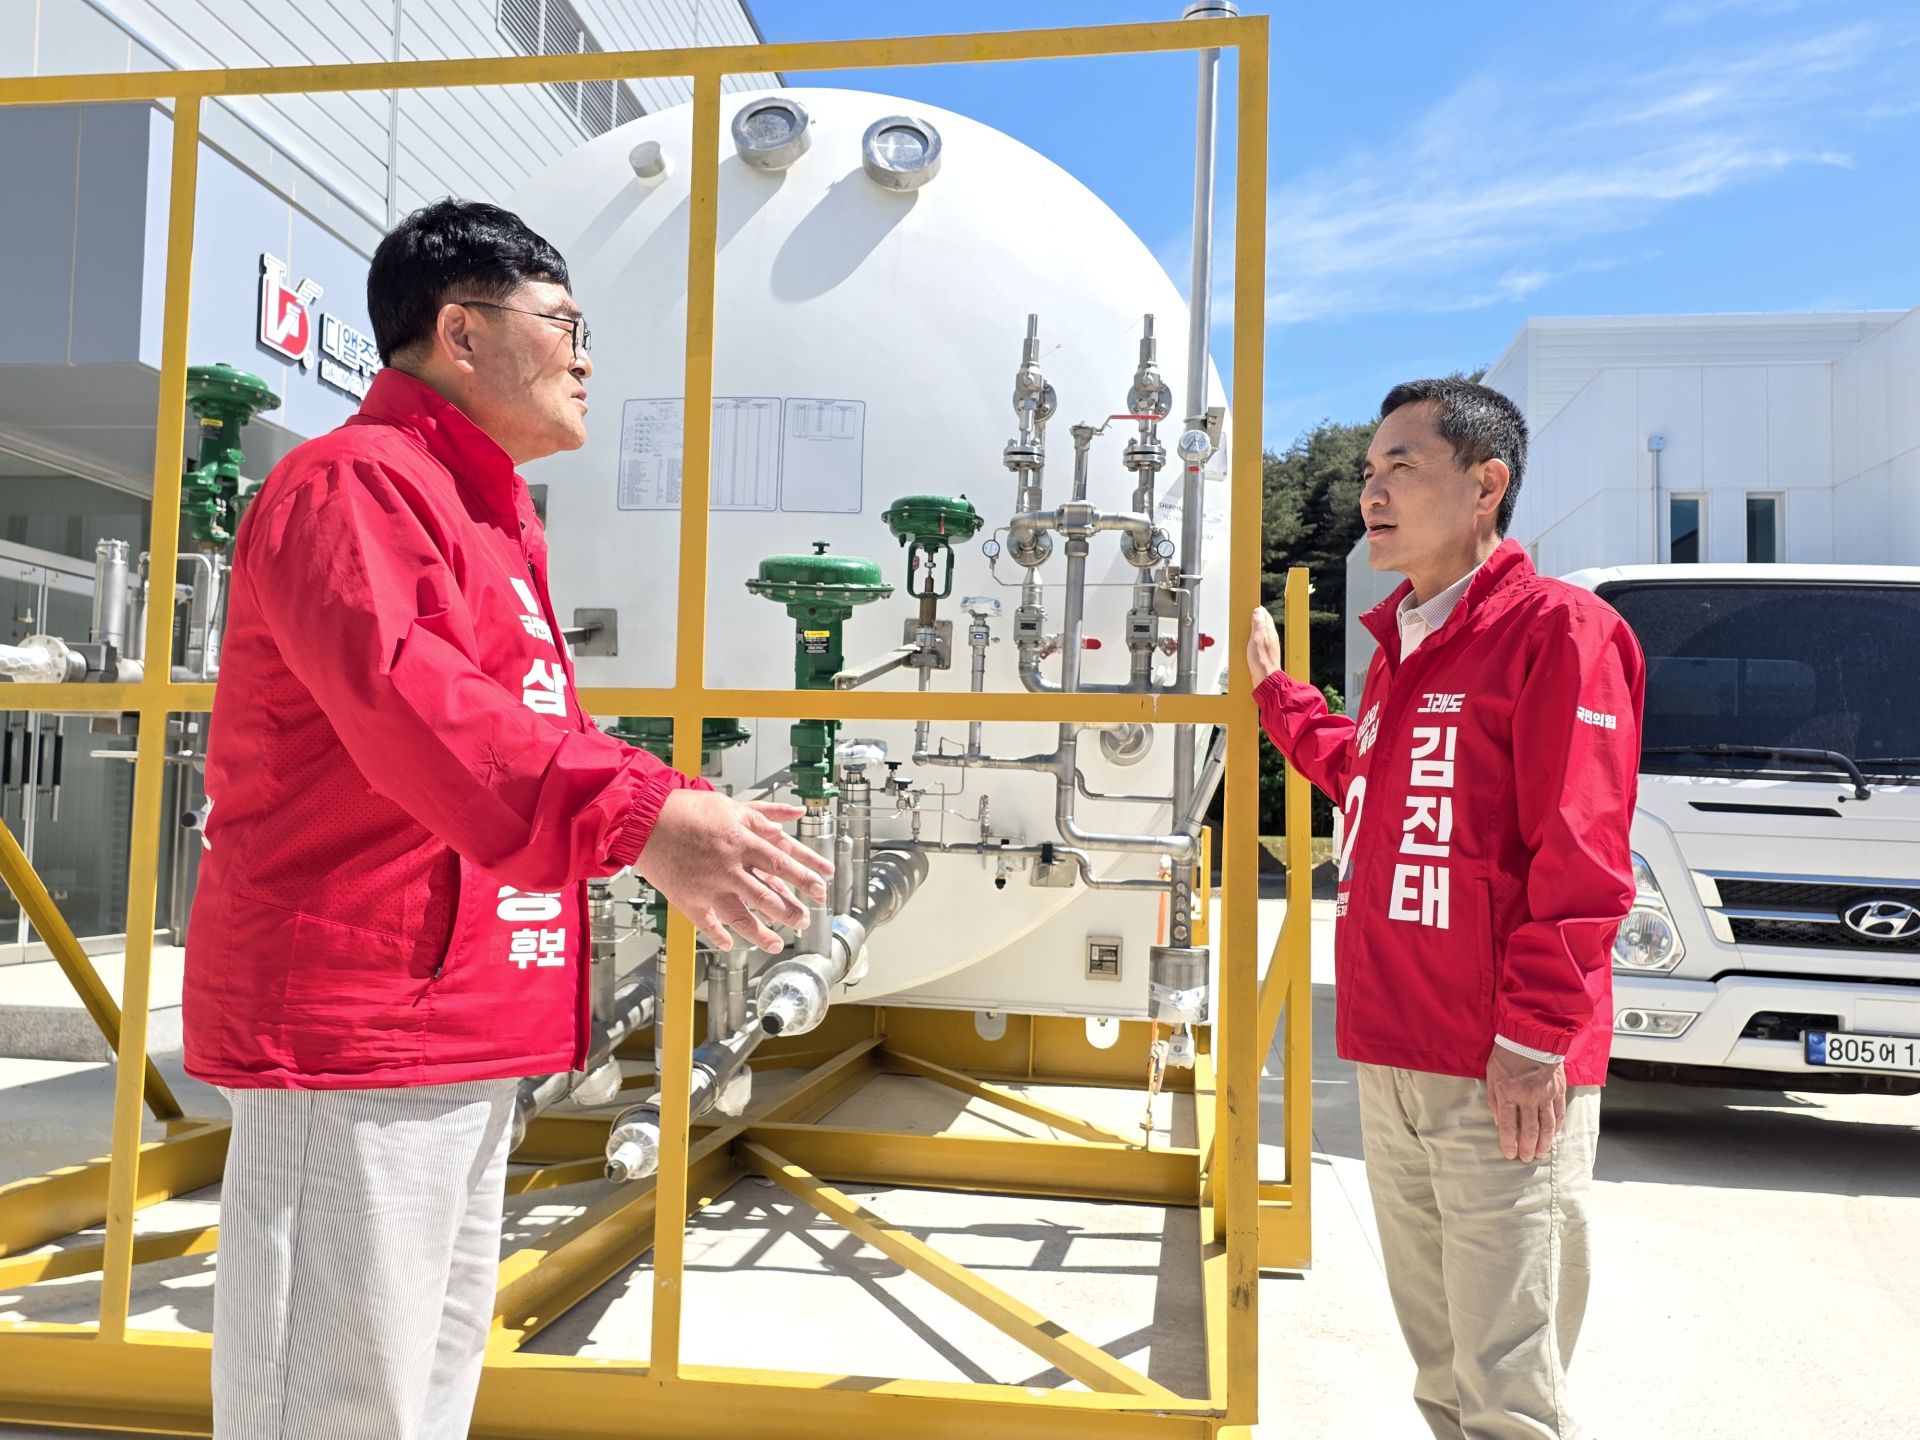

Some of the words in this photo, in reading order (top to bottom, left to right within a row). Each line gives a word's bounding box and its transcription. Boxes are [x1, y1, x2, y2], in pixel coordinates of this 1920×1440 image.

[1417, 693, 1466, 713] 그래도
[1576, 705, 1617, 730] 국민의힘
[1388, 726, 1458, 929] 김진태
[508, 928, 566, 970] 후보
[1829, 1038, 1895, 1064] 805어
